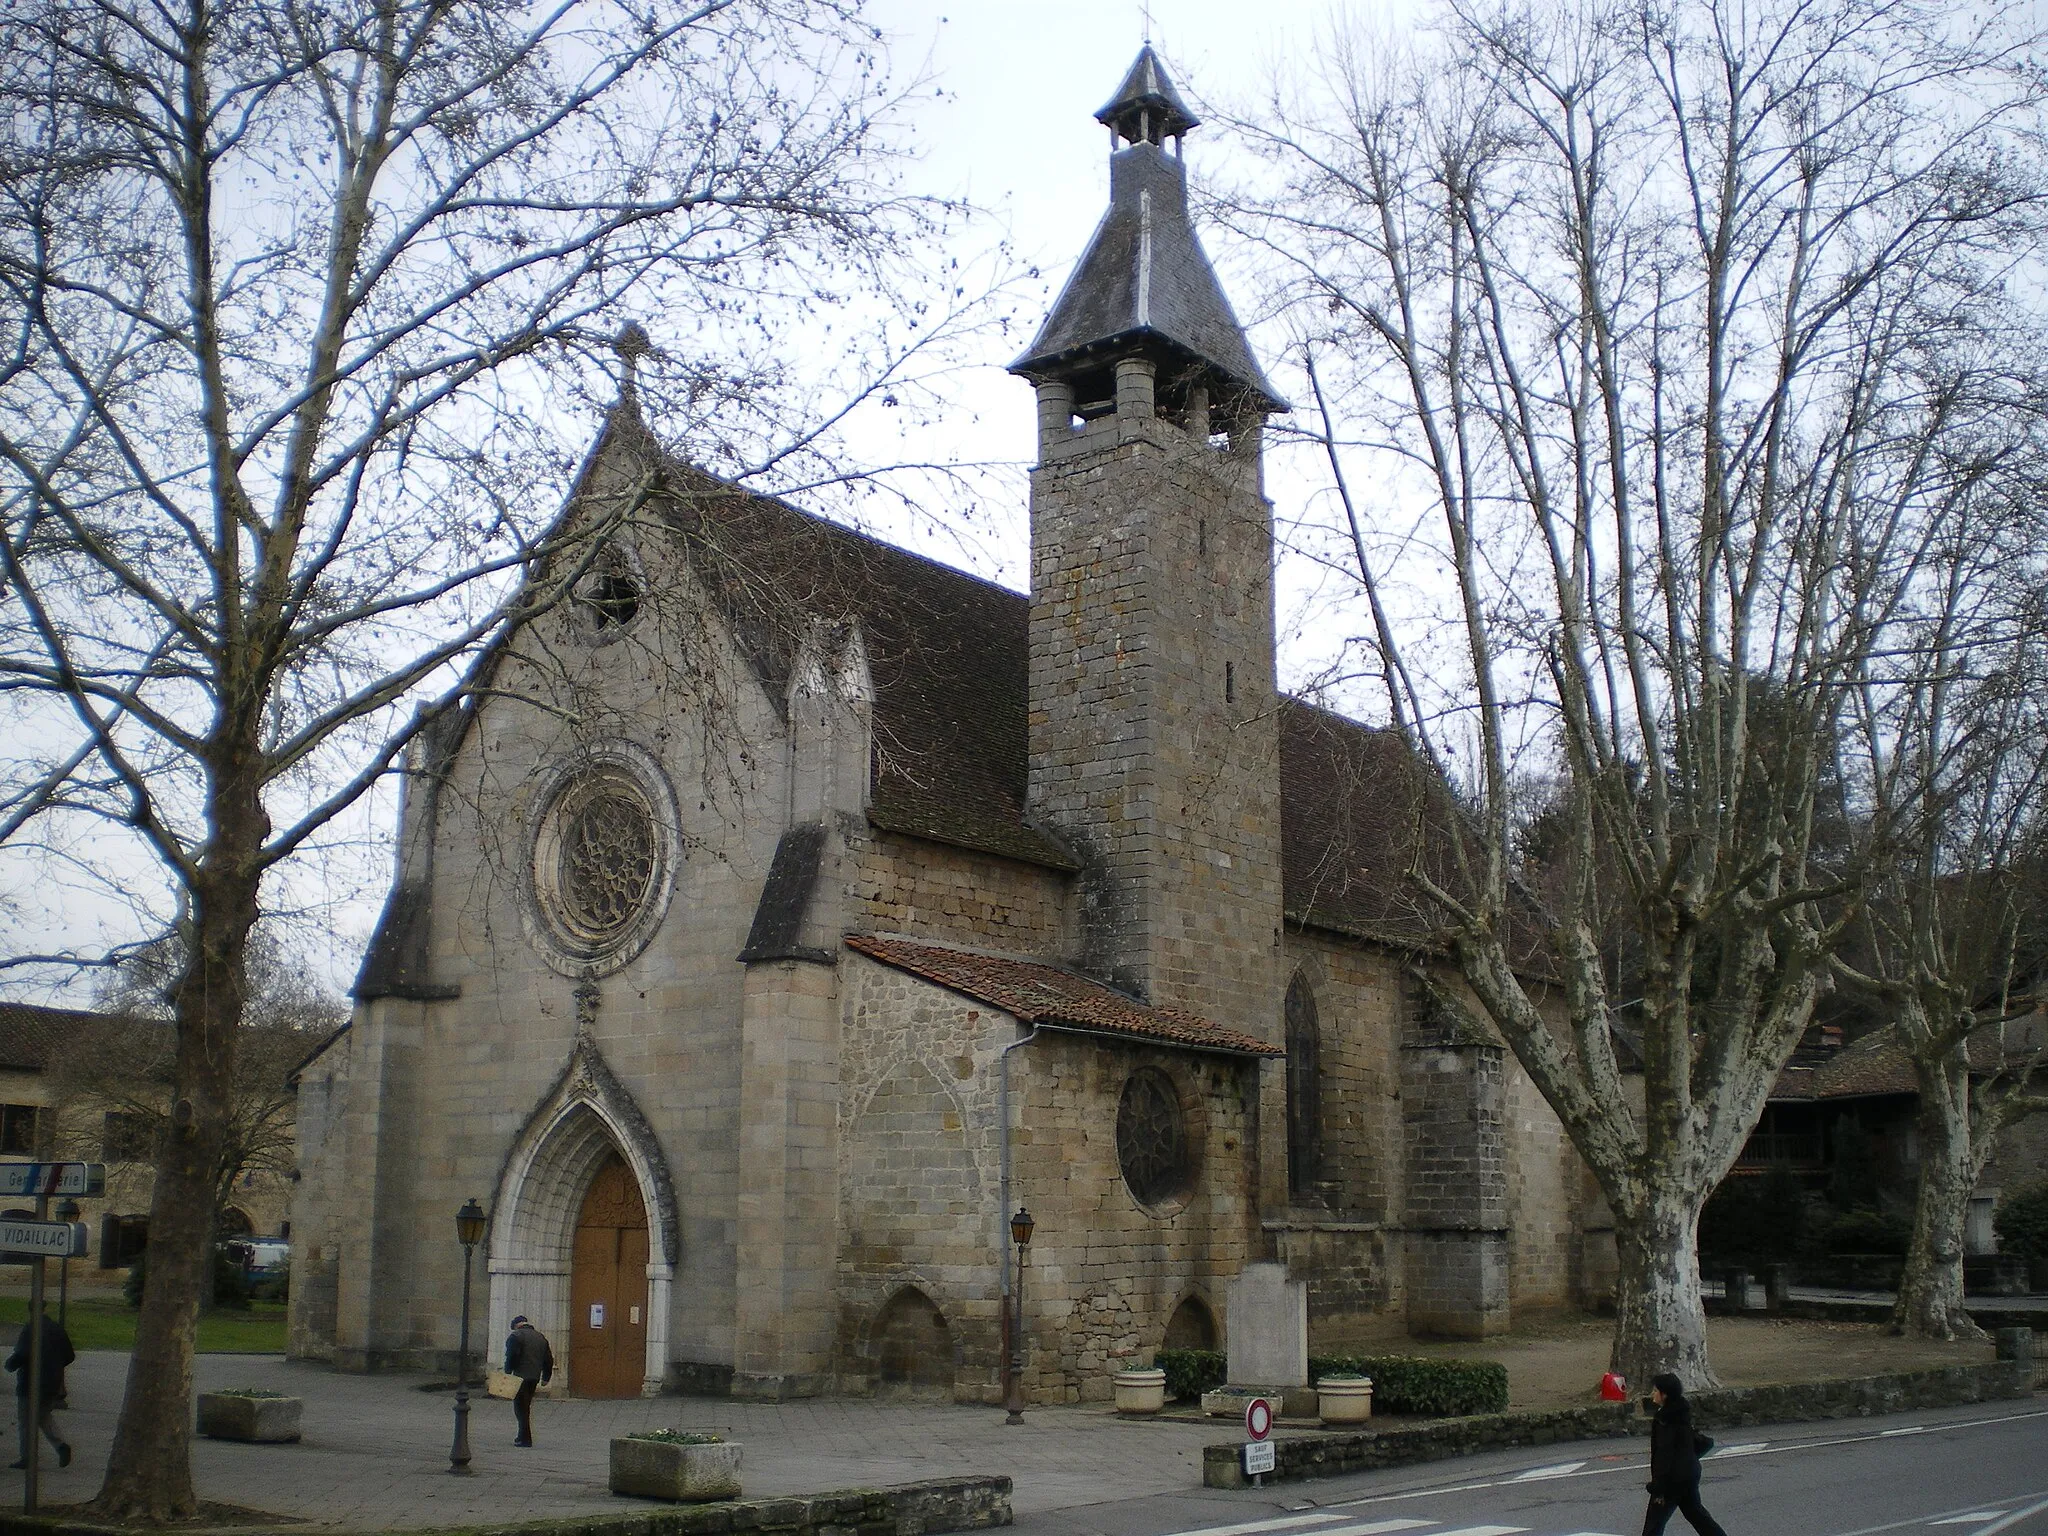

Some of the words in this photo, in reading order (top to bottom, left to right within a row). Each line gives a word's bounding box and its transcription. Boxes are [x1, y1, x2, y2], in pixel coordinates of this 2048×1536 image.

[9, 1172, 79, 1187] Genarerie
[5, 1228, 65, 1246] VIDAILLAC
[1249, 1453, 1273, 1463] SERVICES
[1250, 1462, 1272, 1472] PUBLICS
